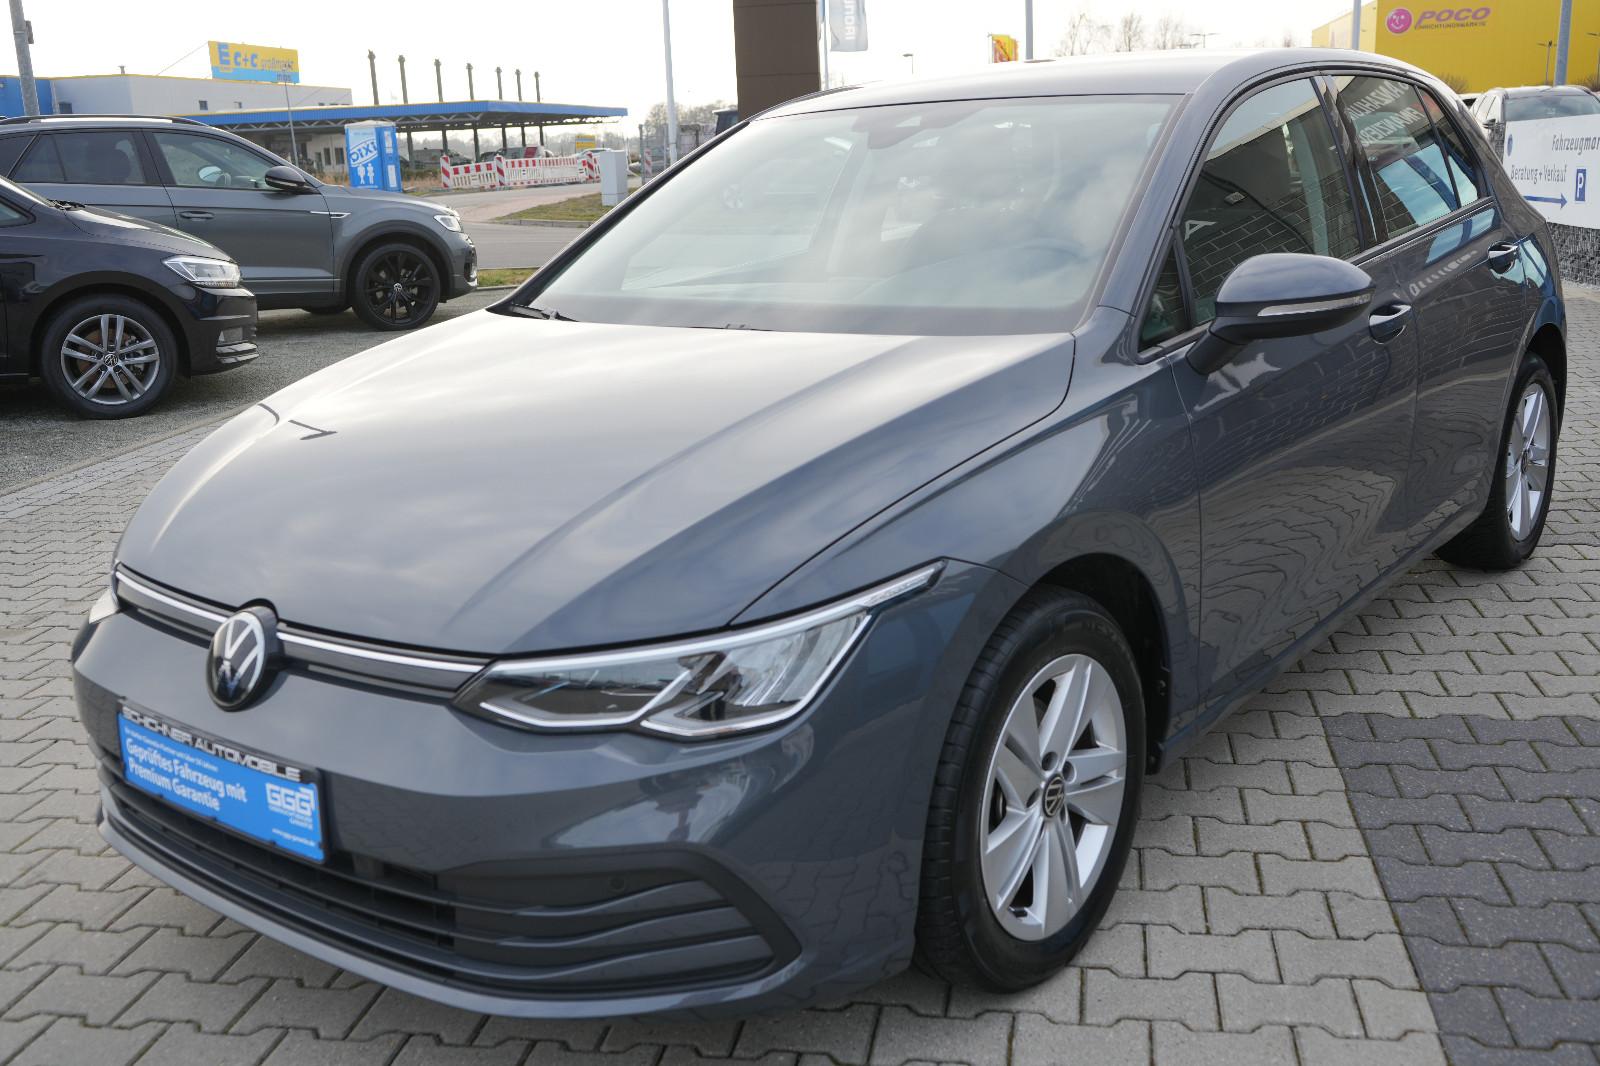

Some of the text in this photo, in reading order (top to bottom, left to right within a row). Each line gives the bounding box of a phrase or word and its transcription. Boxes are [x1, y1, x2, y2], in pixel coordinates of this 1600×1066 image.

[1415, 7, 1491, 30] POCO
[1510, 164, 1539, 185] Beratung
[1543, 163, 1568, 183] Verkauf
[126, 737, 174, 774] Geprüftes
[172, 758, 226, 798] Fahrzeug
[225, 782, 248, 803] mit
[194, 737, 302, 783] AUTOMOBILE
[128, 755, 221, 812] Premium Garantie
